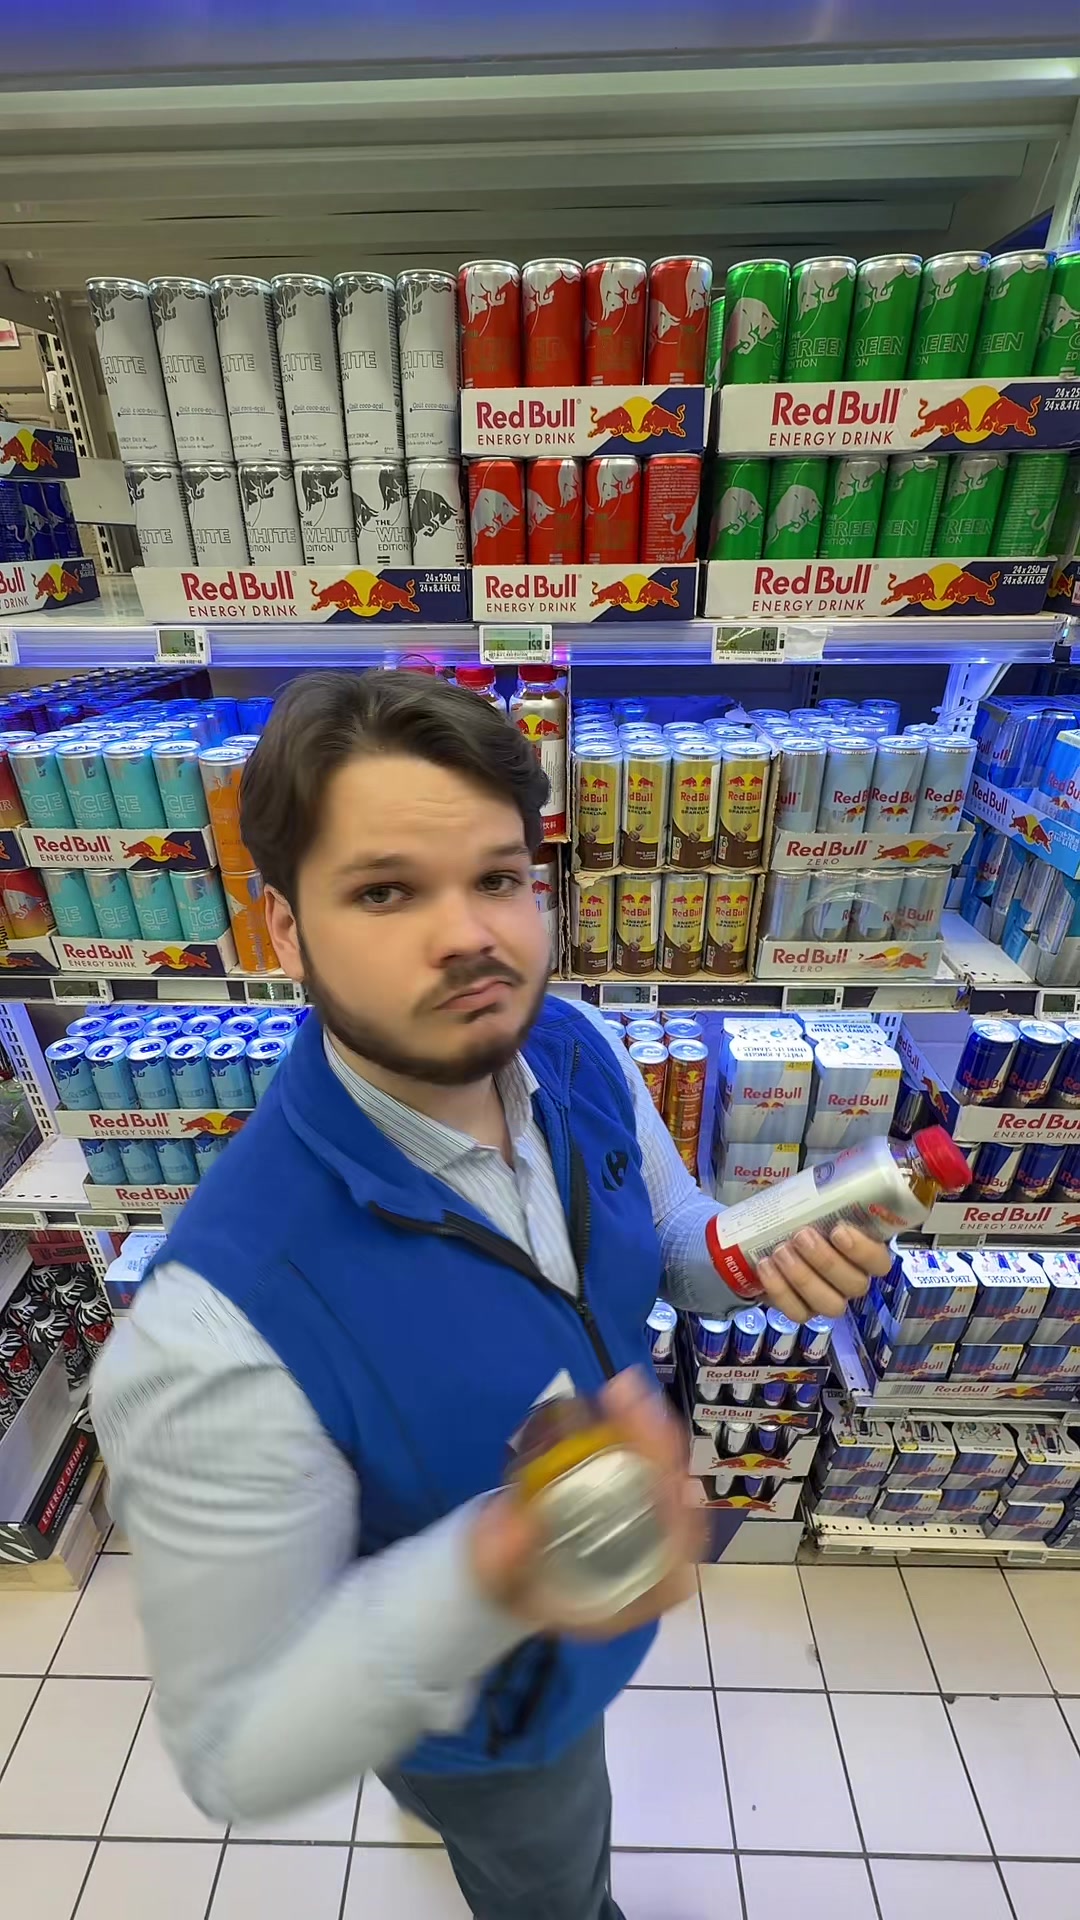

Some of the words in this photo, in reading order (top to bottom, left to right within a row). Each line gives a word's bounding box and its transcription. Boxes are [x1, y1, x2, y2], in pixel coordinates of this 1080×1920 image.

[854, 335, 904, 358] REEN
[101, 355, 147, 374] HITE
[161, 355, 207, 374] HITE
[280, 352, 322, 371] HITE
[402, 350, 444, 369] HITE
[476, 400, 524, 429] Red
[529, 398, 576, 428] Bull
[772, 389, 836, 426] Red
[838, 388, 901, 425] Bull
[478, 433, 530, 446] ENERGY
[535, 432, 576, 444] DRINK
[769, 432, 836, 446] ENERGY
[842, 431, 894, 445] DRINK
[192, 528, 232, 544] HITE
[304, 527, 356, 544] WHITE
[378, 544, 408, 552] EDITION
[181, 571, 238, 601] Red
[239, 570, 294, 600] Bull
[486, 574, 530, 598] Red
[534, 574, 577, 598] Bull
[754, 565, 812, 595] Red
[814, 564, 872, 594] Bull
[4, 597, 30, 609] DRINK
[487, 603, 534, 612] ENERGY
[540, 602, 576, 612] DRINK
[752, 600, 814, 612] ENERGY
[818, 600, 866, 611] DRINK
[188, 606, 246, 617] ENERGY
[252, 605, 298, 616] DRINK
[528, 640, 542, 650] 159
[992, 749, 1010, 761] ull
[1048, 772, 1066, 792] Red
[590, 794, 608, 802] Bull
[636, 792, 652, 802] Bull
[680, 792, 697, 802] Red
[698, 792, 710, 802] Bu
[728, 791, 745, 801] Red
[834, 790, 861, 804] Red
[872, 788, 899, 804] Red
[925, 788, 954, 803] Red
[972, 781, 988, 804] Red
[989, 791, 1008, 816] Bull
[166, 794, 196, 812] CE
[34, 835, 74, 852] Red
[72, 836, 110, 852] Bull
[786, 840, 828, 856] Red
[829, 839, 868, 856] Bull
[40, 854, 80, 862] ENERGY
[84, 854, 114, 862] DRINK
[807, 858, 840, 866] ZERO
[586, 908, 602, 918] Bull
[622, 906, 634, 916] Red
[672, 908, 688, 918] Red
[716, 907, 731, 917] Red
[906, 908, 934, 922] Bull
[62, 944, 98, 958] Red
[98, 945, 134, 960] Bull
[772, 948, 810, 964] Red
[812, 948, 848, 964] Bull
[69, 960, 106, 968] ENERGY
[108, 960, 136, 968] DRINK
[907, 1046, 920, 1070] Bull
[743, 1088, 772, 1099] Red
[774, 1088, 802, 1099] Bull
[828, 1094, 857, 1106] Red
[859, 1094, 888, 1106] Bull
[88, 1112, 129, 1129] Red
[130, 1112, 169, 1128] Bull
[997, 1112, 1046, 1129] Red
[1046, 1113, 1080, 1130] Bu
[140, 1128, 172, 1136] DRINK
[993, 1131, 1042, 1139] ENERGY
[1046, 1132, 1080, 1140] DRIN
[776, 1144, 783, 1152] 4
[734, 1166, 761, 1178] Red
[764, 1166, 790, 1178] Bull
[115, 1188, 156, 1201] Red
[156, 1188, 190, 1201] Bull
[963, 1206, 1008, 1222] Red
[1008, 1206, 1052, 1222] Bull
[725, 1256, 738, 1273] RED
[943, 1305, 966, 1314] Bull
[1014, 1305, 1037, 1314] Bull
[920, 1362, 944, 1370] Bull
[986, 1362, 1010, 1371] Bull
[1058, 1364, 1080, 1373] Bull
[706, 1370, 732, 1378] Red
[734, 1370, 759, 1378] Bull
[702, 1408, 726, 1417] Red
[728, 1409, 752, 1418] Bull
[42, 1478, 66, 1525] ENERGY
[66, 1442, 85, 1476] DRINK
